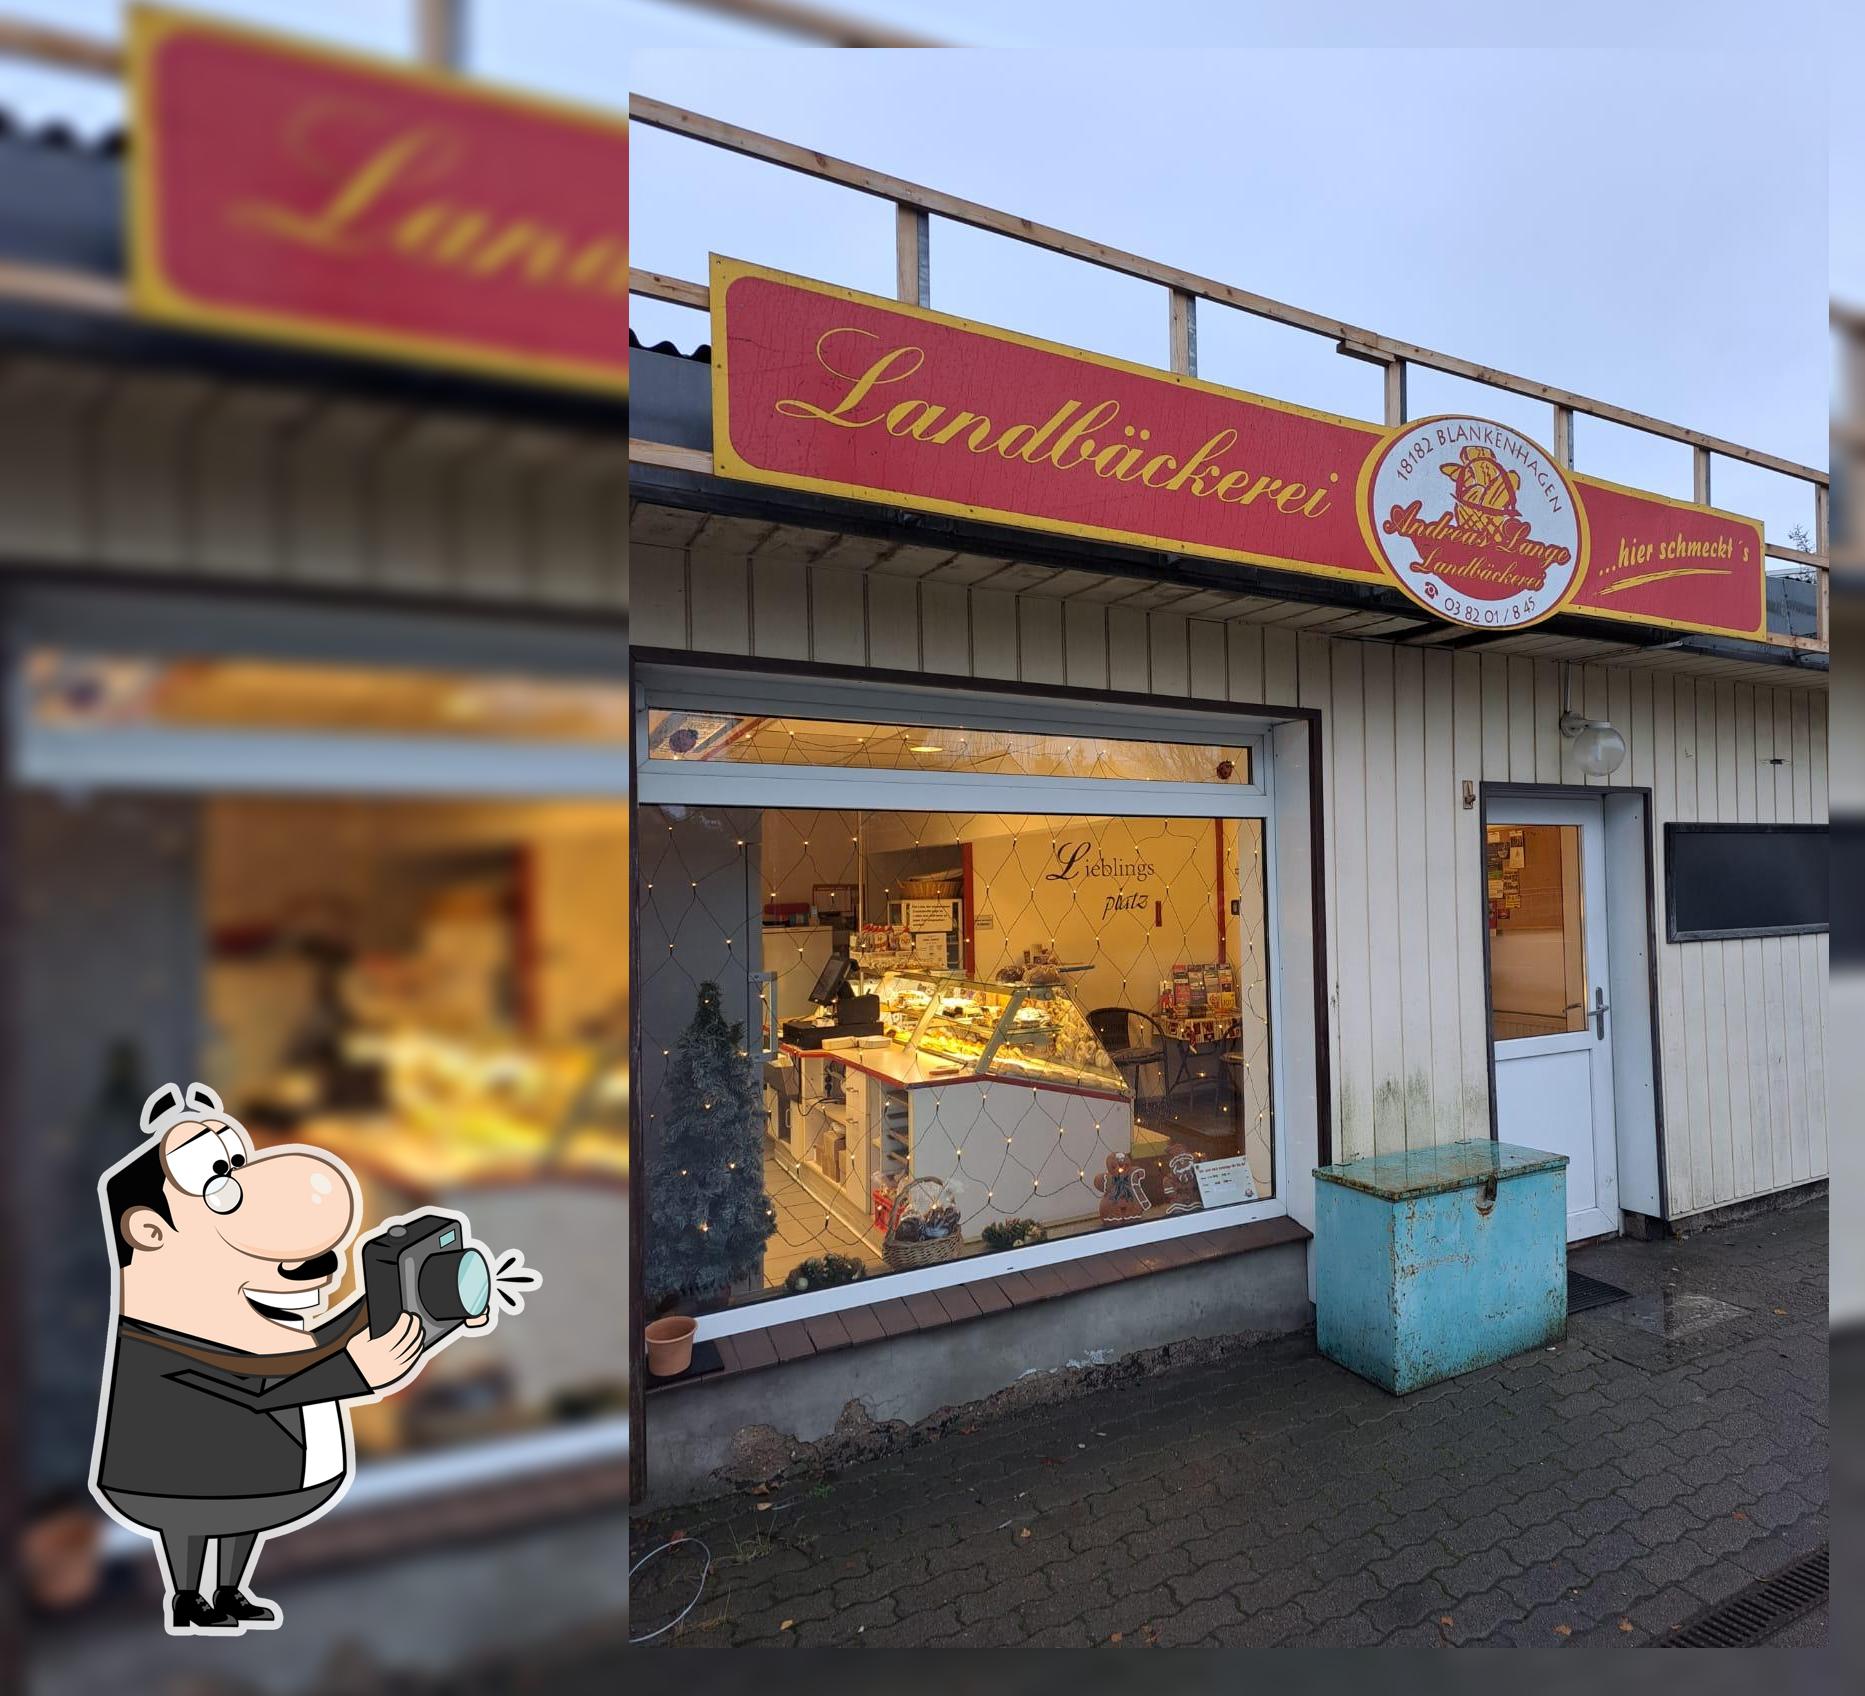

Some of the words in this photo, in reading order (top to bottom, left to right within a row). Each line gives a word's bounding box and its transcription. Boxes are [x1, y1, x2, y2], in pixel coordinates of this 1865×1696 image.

[220, 94, 629, 293] Lan
[774, 327, 1340, 518] Landbäckerei
[1396, 437, 1434, 481] 18182
[1436, 424, 1562, 513] BLANKENHAGEN
[1385, 502, 1490, 548] Andreas
[1496, 517, 1570, 568] Lange
[1411, 545, 1545, 590] Landbäckerei
[1444, 597, 1461, 616] 03
[1465, 606, 1480, 624] 82
[1485, 609, 1499, 624] 01
[1512, 605, 1521, 620] 8
[1523, 596, 1536, 613] 45
[1045, 841, 1155, 882] Lieblings
[1101, 892, 1150, 921] platz
